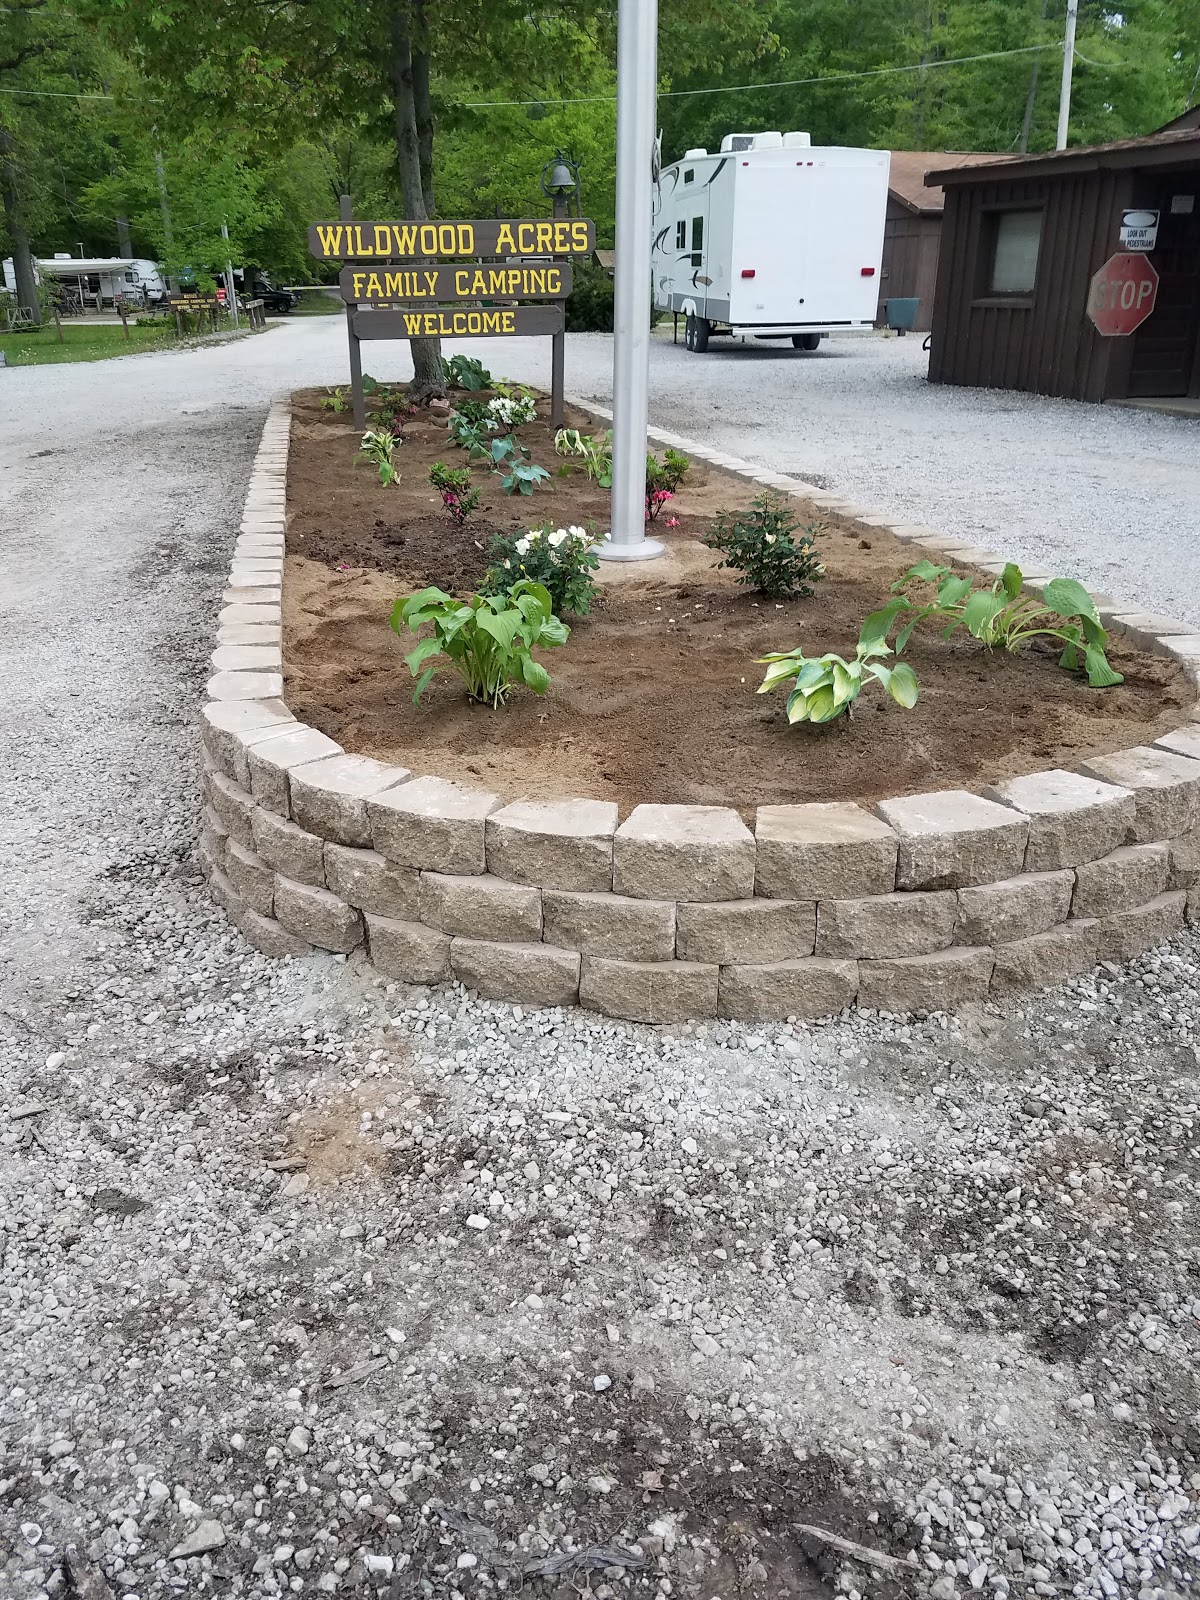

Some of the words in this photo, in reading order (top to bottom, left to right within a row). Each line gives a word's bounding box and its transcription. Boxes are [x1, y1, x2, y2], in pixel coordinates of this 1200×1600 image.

[316, 224, 474, 256] WILDWOOD
[495, 222, 588, 253] ACRES
[1127, 229, 1138, 238] LOOK
[1138, 229, 1147, 238] OUT
[1127, 239, 1153, 247] PEDESTRIANS
[352, 271, 439, 298] FAMILY
[455, 269, 562, 295] CAMPING
[1094, 280, 1153, 310] STOP
[403, 311, 516, 335] WELCOME
